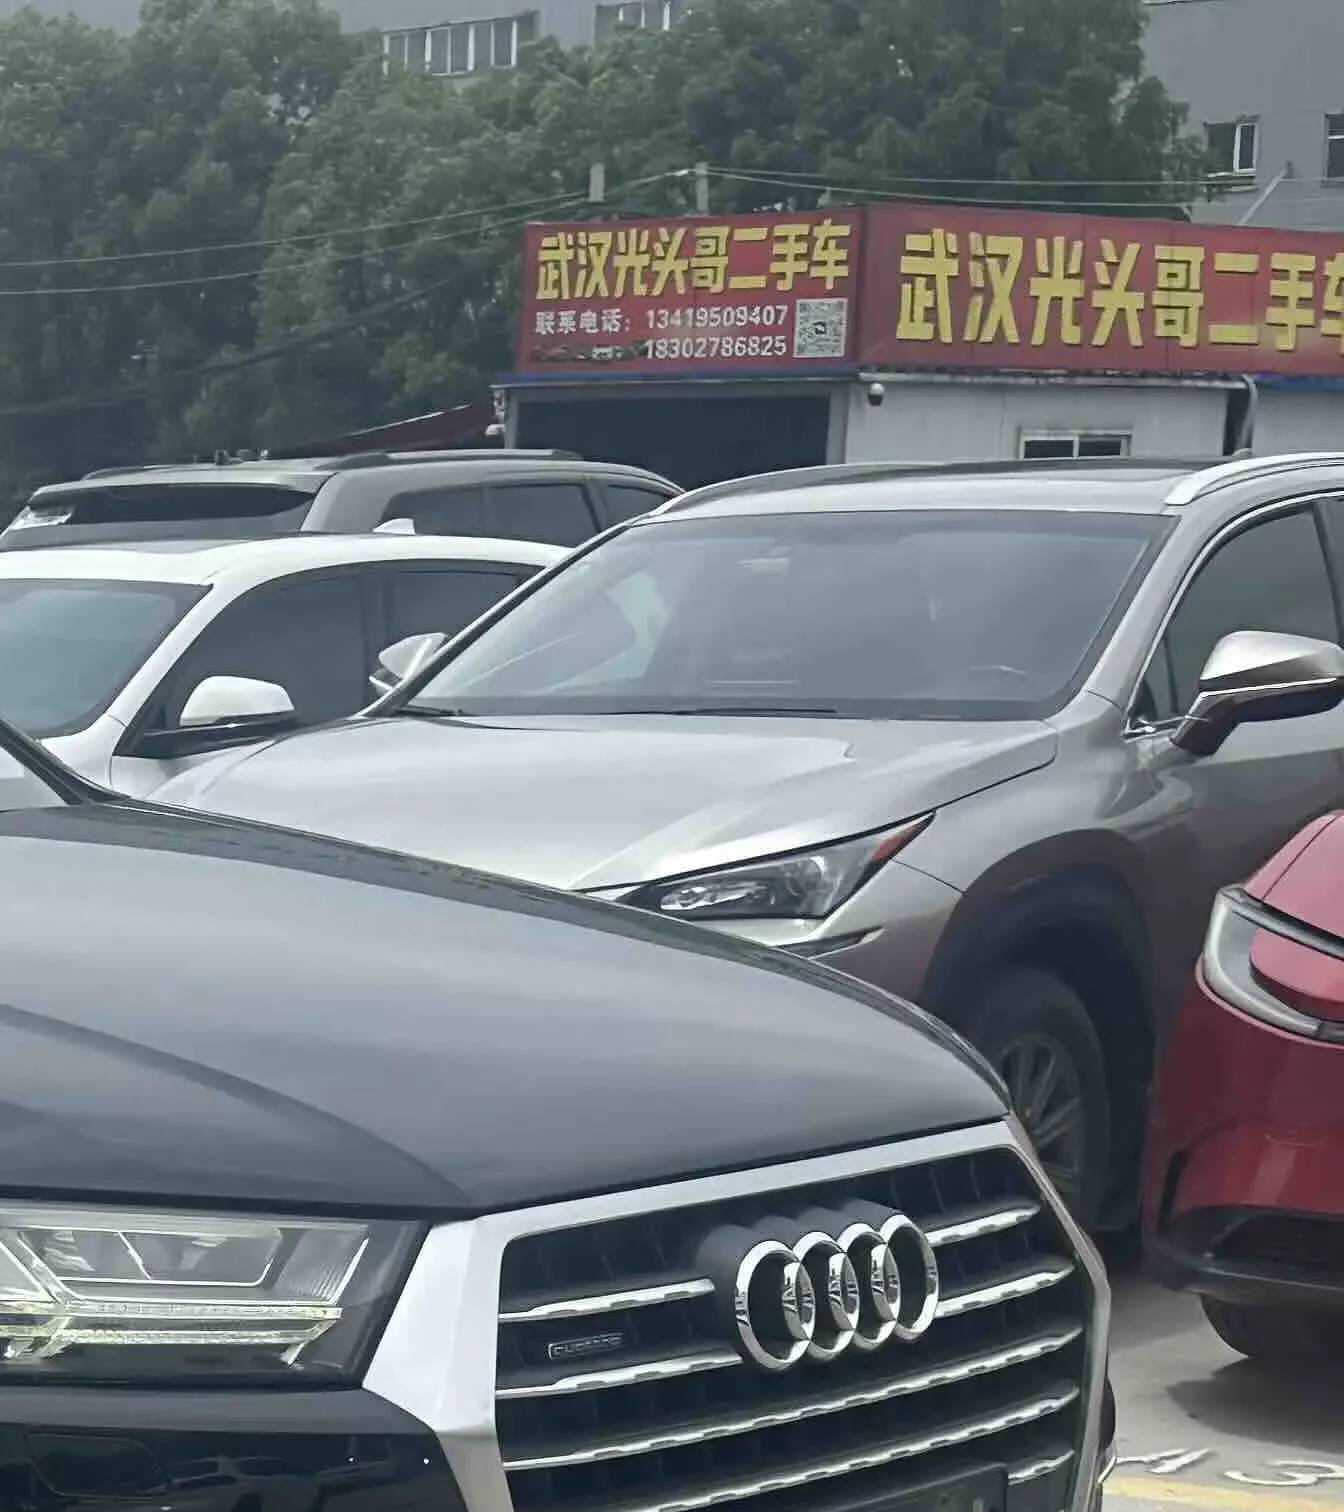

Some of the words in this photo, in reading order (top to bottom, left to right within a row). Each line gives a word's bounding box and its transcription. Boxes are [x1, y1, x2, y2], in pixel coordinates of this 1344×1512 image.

[536, 218, 852, 300] 武汉光头哥二手车
[645, 336, 787, 359] 18302786825
